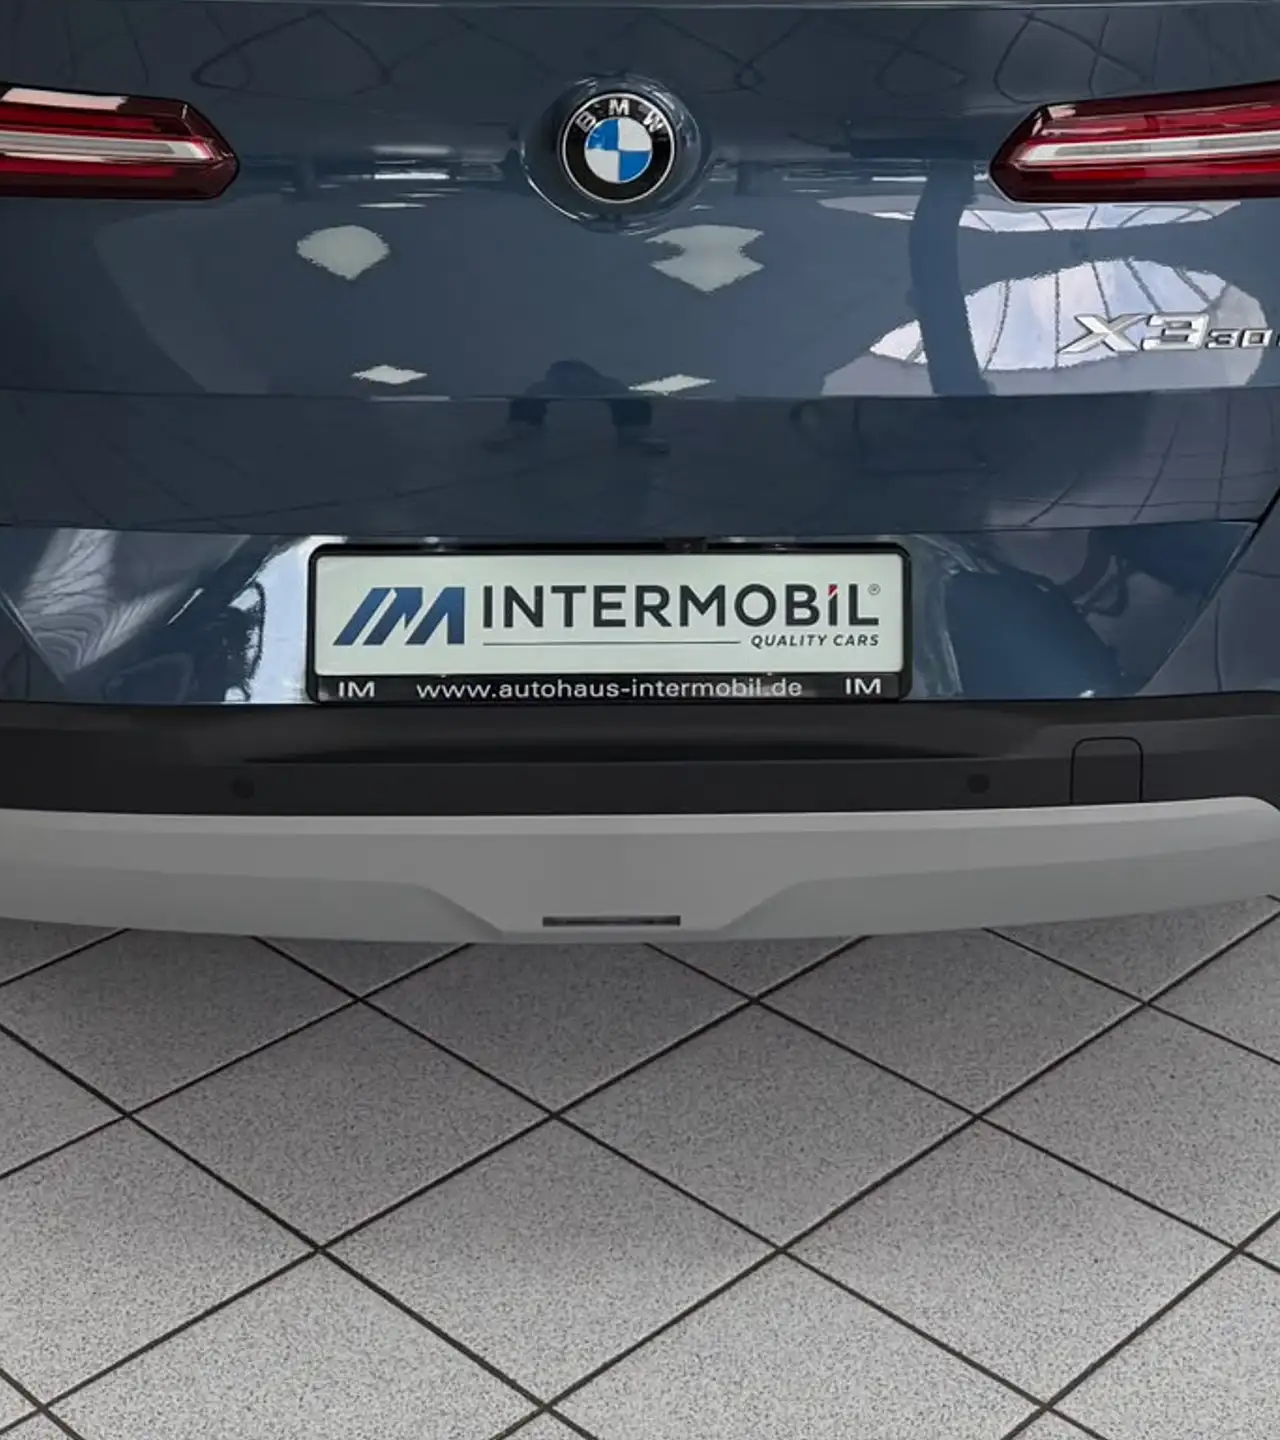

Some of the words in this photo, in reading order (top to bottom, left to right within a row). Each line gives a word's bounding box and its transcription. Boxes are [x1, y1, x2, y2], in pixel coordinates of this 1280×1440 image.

[575, 98, 665, 133] BMW
[750, 633, 827, 650] QUALITY
[833, 633, 880, 647] CARS
[337, 680, 376, 699] IM
[415, 676, 803, 698] www.autohaus-intermobil.de
[845, 677, 882, 696] IM
